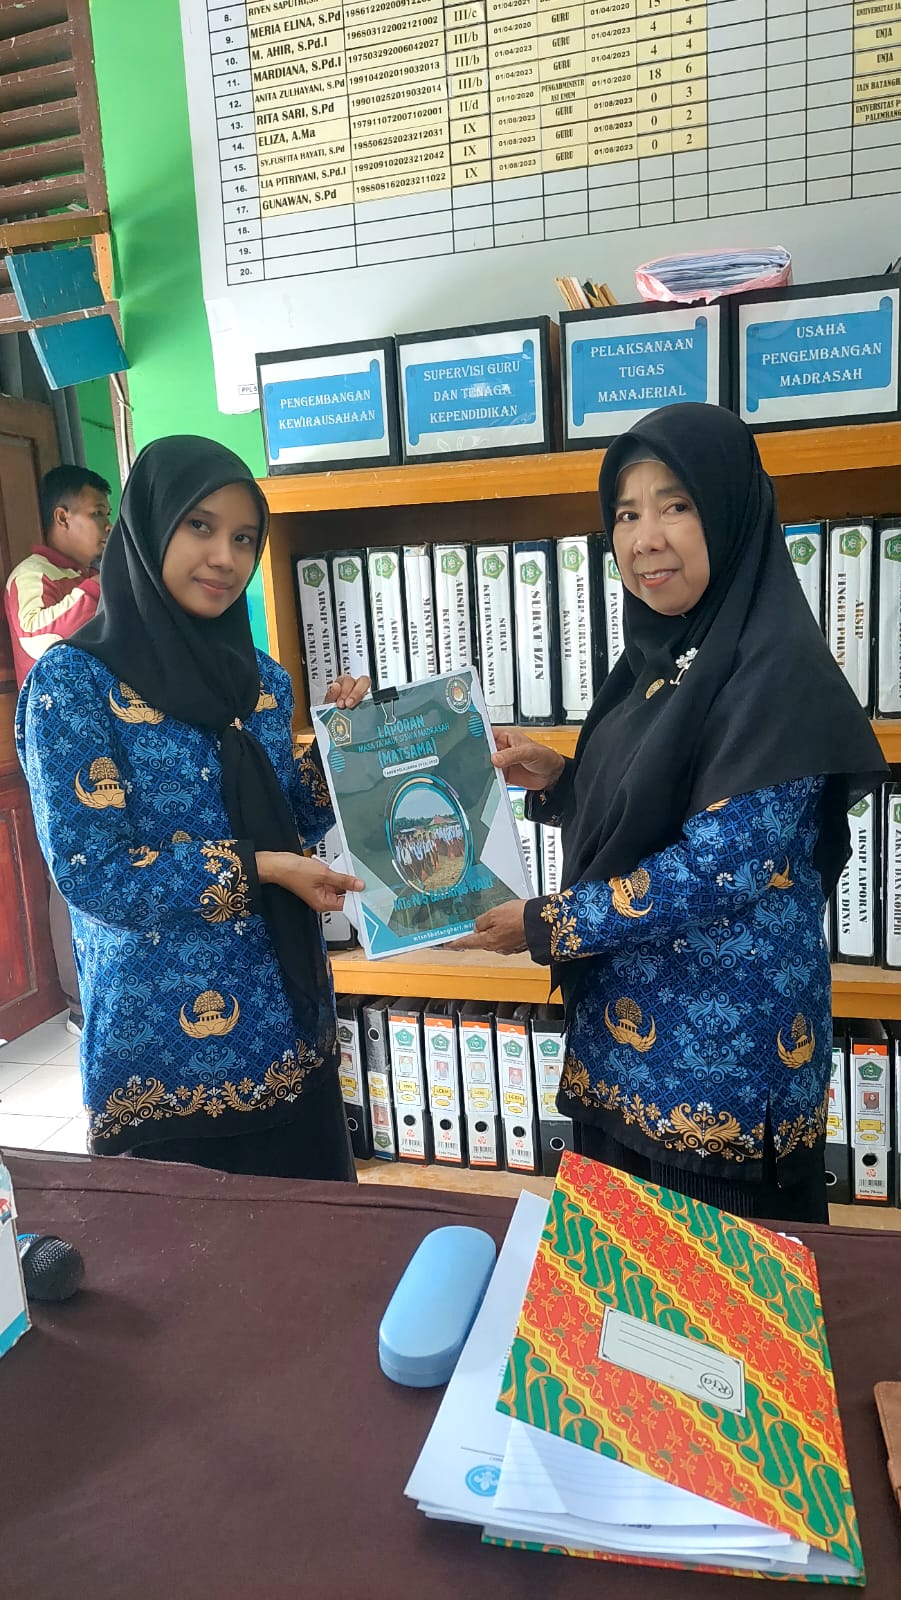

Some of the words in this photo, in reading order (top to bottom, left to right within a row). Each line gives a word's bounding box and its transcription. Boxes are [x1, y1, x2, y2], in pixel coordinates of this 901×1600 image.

[454, 9, 478, 22] III/c
[590, 2, 630, 16] 01/04/2020
[224, 14, 232, 22] 8.
[250, 25, 282, 39] MERIA
[284, 17, 315, 32] ELINA,
[318, 10, 341, 24] S.Pd
[552, 12, 570, 23] GURU
[686, 14, 692, 24] 4
[494, 22, 532, 34] 01/04/2020
[592, 26, 631, 40] 01/04/2023
[650, 21, 656, 31] 4
[225, 36, 234, 44] 9.
[454, 32, 479, 45] III/b
[552, 36, 570, 48] GURU
[686, 38, 692, 48] 4
[252, 50, 264, 60] M.
[266, 44, 294, 58] AHIR,
[298, 36, 328, 52] S.Pd.I
[494, 45, 532, 58] 01/04/2023
[650, 44, 658, 54] 4
[225, 57, 238, 66] 10.
[456, 54, 480, 68] III/b
[592, 50, 630, 62] 01/04/2023
[254, 64, 308, 82] MARDIANA,
[312, 56, 342, 72] S.Pd.I
[553, 60, 572, 70] GURU
[686, 62, 692, 73] 6
[650, 68, 662, 80] 18
[227, 79, 240, 88] 11.
[458, 77, 483, 90] III/b
[254, 91, 278, 104] ANITA
[326, 79, 344, 90] S.Pd
[686, 86, 692, 98] 3
[229, 100, 242, 109] 12.
[460, 99, 479, 112] II/d
[556, 106, 574, 116] GURU
[256, 112, 279, 126] RITA
[282, 108, 308, 121] SARI,
[312, 102, 334, 116] S.Pd
[686, 109, 692, 120] 2
[230, 122, 244, 130] 13.
[463, 122, 477, 134] IX
[258, 133, 288, 147] ELIZA,
[292, 128, 316, 141] A.Ma
[556, 128, 574, 140] GURU
[686, 134, 692, 144] 2
[232, 143, 245, 151] 14.
[328, 145, 345, 155] S.Pd
[464, 144, 477, 157] IX
[556, 150, 574, 162] GURU
[234, 164, 246, 172] 15.
[465, 167, 478, 179] IX
[260, 178, 274, 189] LIA
[322, 166, 346, 178] S.Pd.I
[235, 185, 248, 194] 16.
[262, 194, 312, 211] GUNAWAN,
[314, 188, 337, 202] S.Pd
[236, 206, 248, 214] 17.
[238, 226, 250, 236] 18.
[238, 247, 252, 256] 19.
[240, 267, 252, 276] 20.
[796, 322, 848, 338] USAHA
[590, 338, 694, 358] PELAKSANAAN
[762, 342, 882, 366] PENGEMBANGAN
[424, 364, 484, 382] SUPERVISI
[486, 360, 520, 375] GURU
[618, 363, 665, 378] TUGAS
[779, 367, 863, 388] MADRASAH
[280, 389, 371, 410] PENGEMBANGAN
[432, 389, 458, 402] DAN
[461, 384, 512, 400] TENAGA
[598, 384, 687, 403] MANAJERIAL
[279, 410, 376, 430] KEWIRAUSAHAAN
[429, 404, 518, 424] KEPENDIDIKAN
[455, 580, 465, 618] ARSIP
[576, 574, 585, 613] ARSIP
[837, 573, 847, 622] FINGER
[317, 589, 328, 625] ARSIP
[374, 592, 385, 630] SURAT
[338, 600, 348, 638] SURAT
[531, 590, 543, 643] SURAT
[855, 600, 865, 640] ARSIP
[610, 592, 620, 658] PANGGILAN
[354, 621, 364, 658] ARSIP
[390, 618, 400, 654] ARSIP
[498, 617, 508, 654] SURAT
[578, 616, 586, 656] SURAT
[306, 623, 318, 680] KEMENAG
[322, 628, 332, 666] SURAT
[377, 634, 388, 680] PINDAH
[534, 647, 544, 681] IZIN
[488, 661, 496, 696] SISWA
[580, 659, 588, 702] MASUK
[377, 714, 425, 740] LAPORAN
[858, 827, 868, 864] ARSIP
[858, 867, 868, 924] LAPORAN
[841, 899, 850, 935] DINAS
[703, 1377, 731, 1395] Ria
